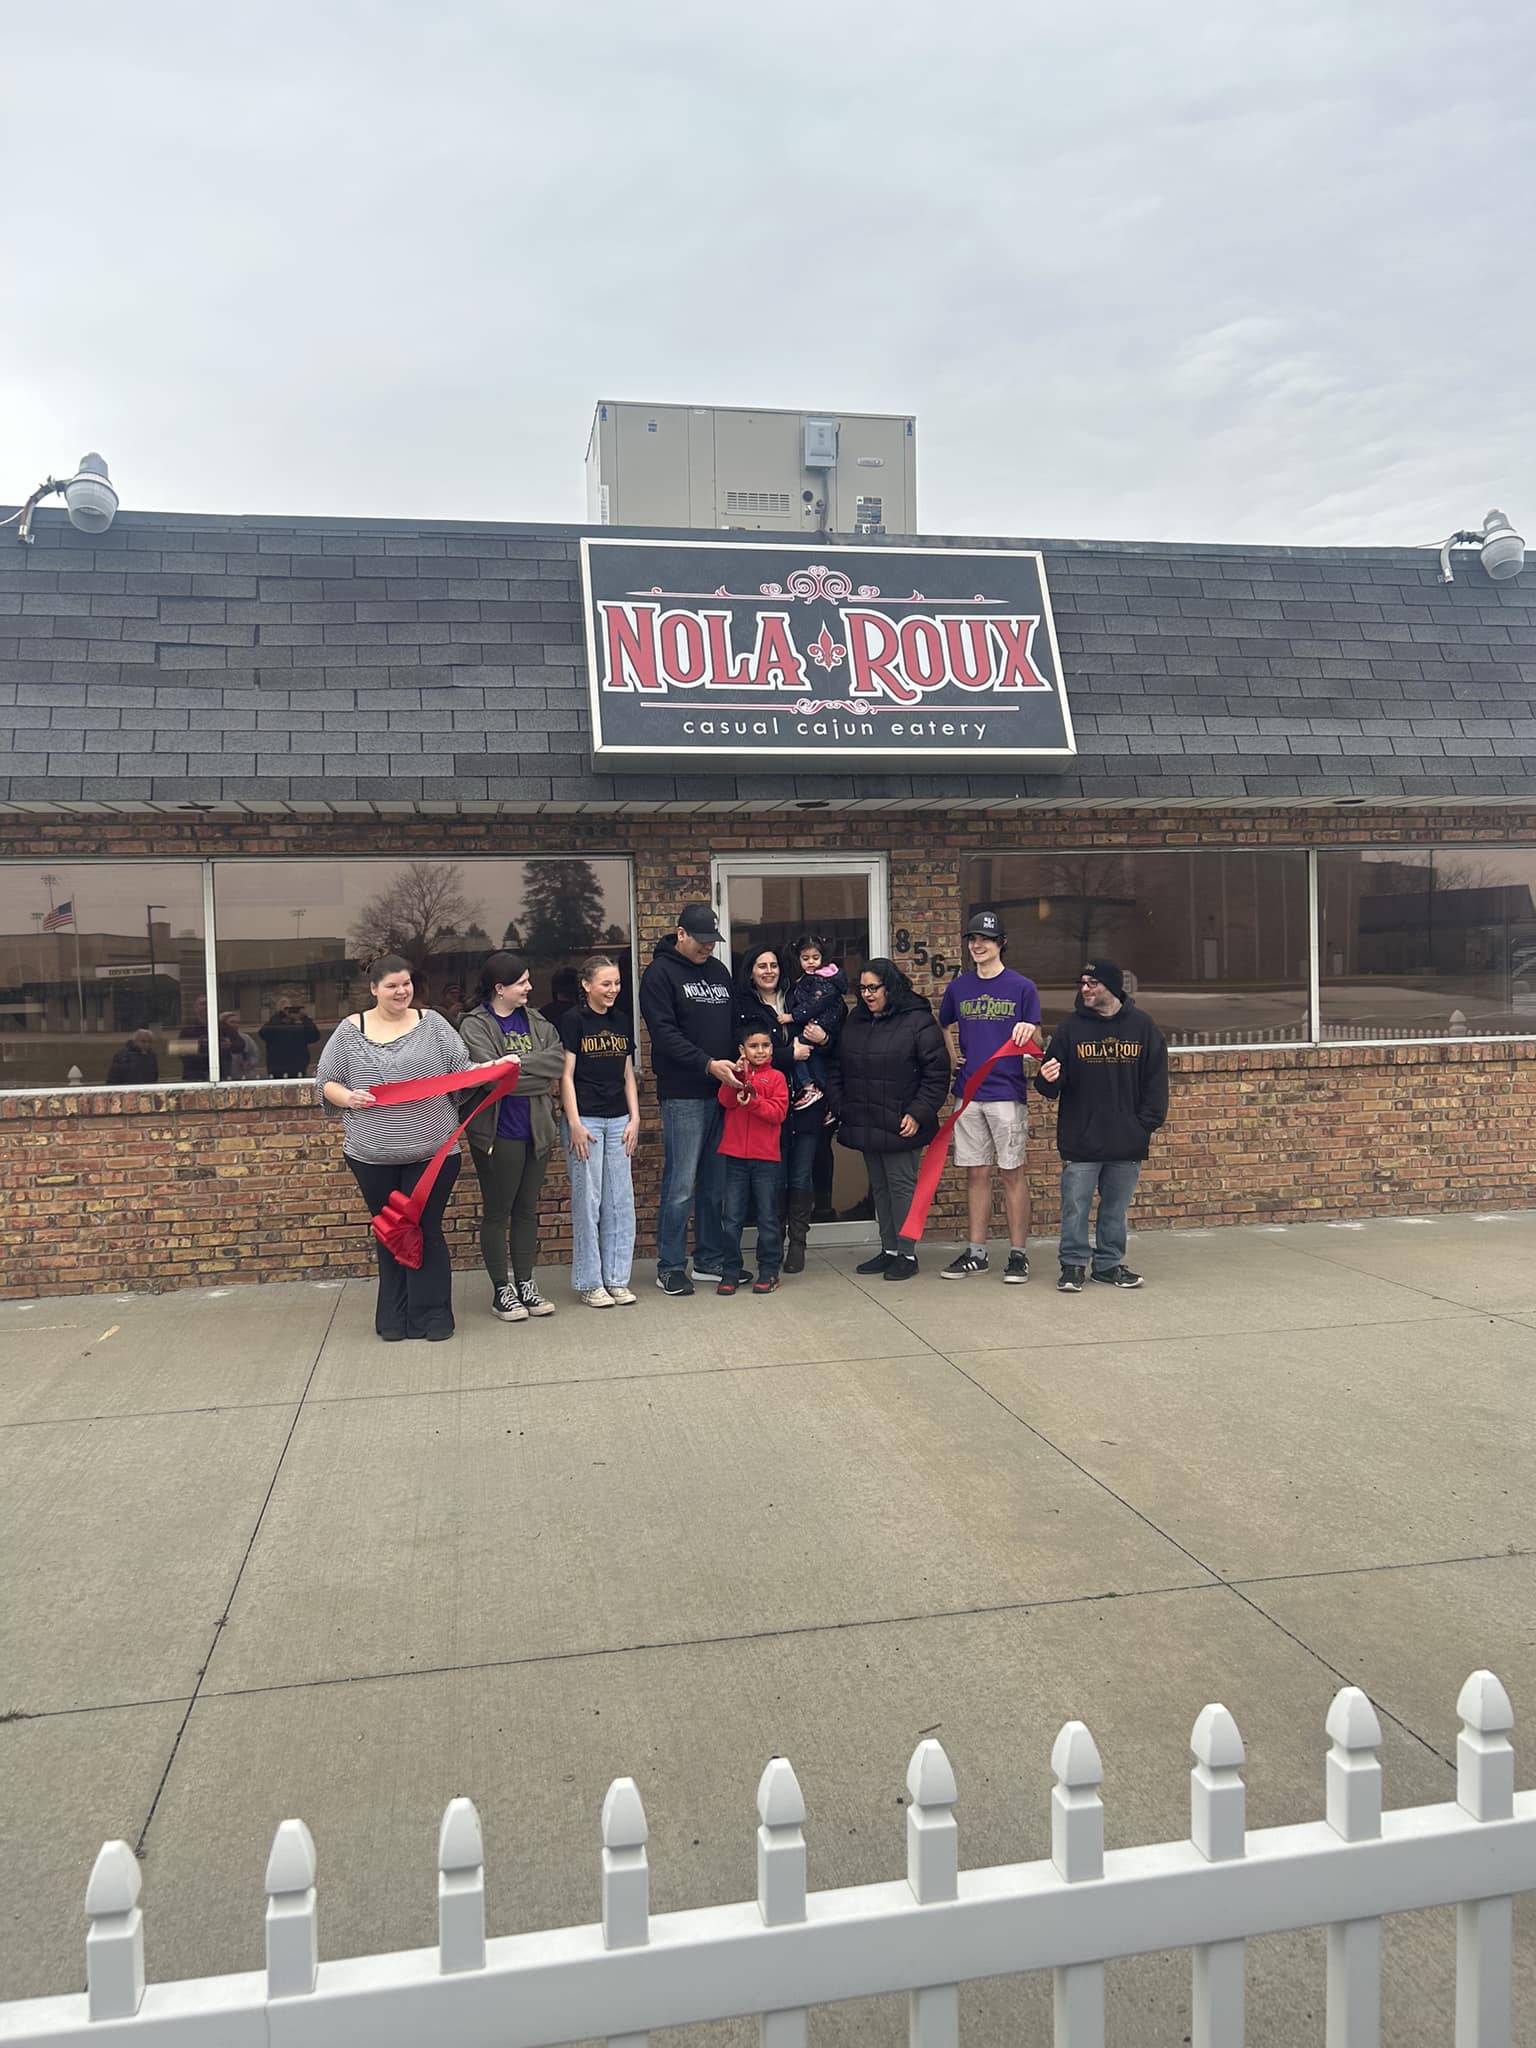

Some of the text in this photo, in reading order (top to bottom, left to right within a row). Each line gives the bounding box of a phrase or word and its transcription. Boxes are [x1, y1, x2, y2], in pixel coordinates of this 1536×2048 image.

[597, 600, 1054, 705] NOLA ROUX
[682, 716, 987, 741] casual cajun eatery
[987, 1000, 1016, 1016] ROUX
[581, 1036, 607, 1053] NOLA
[1077, 1043, 1107, 1058] NOLA
